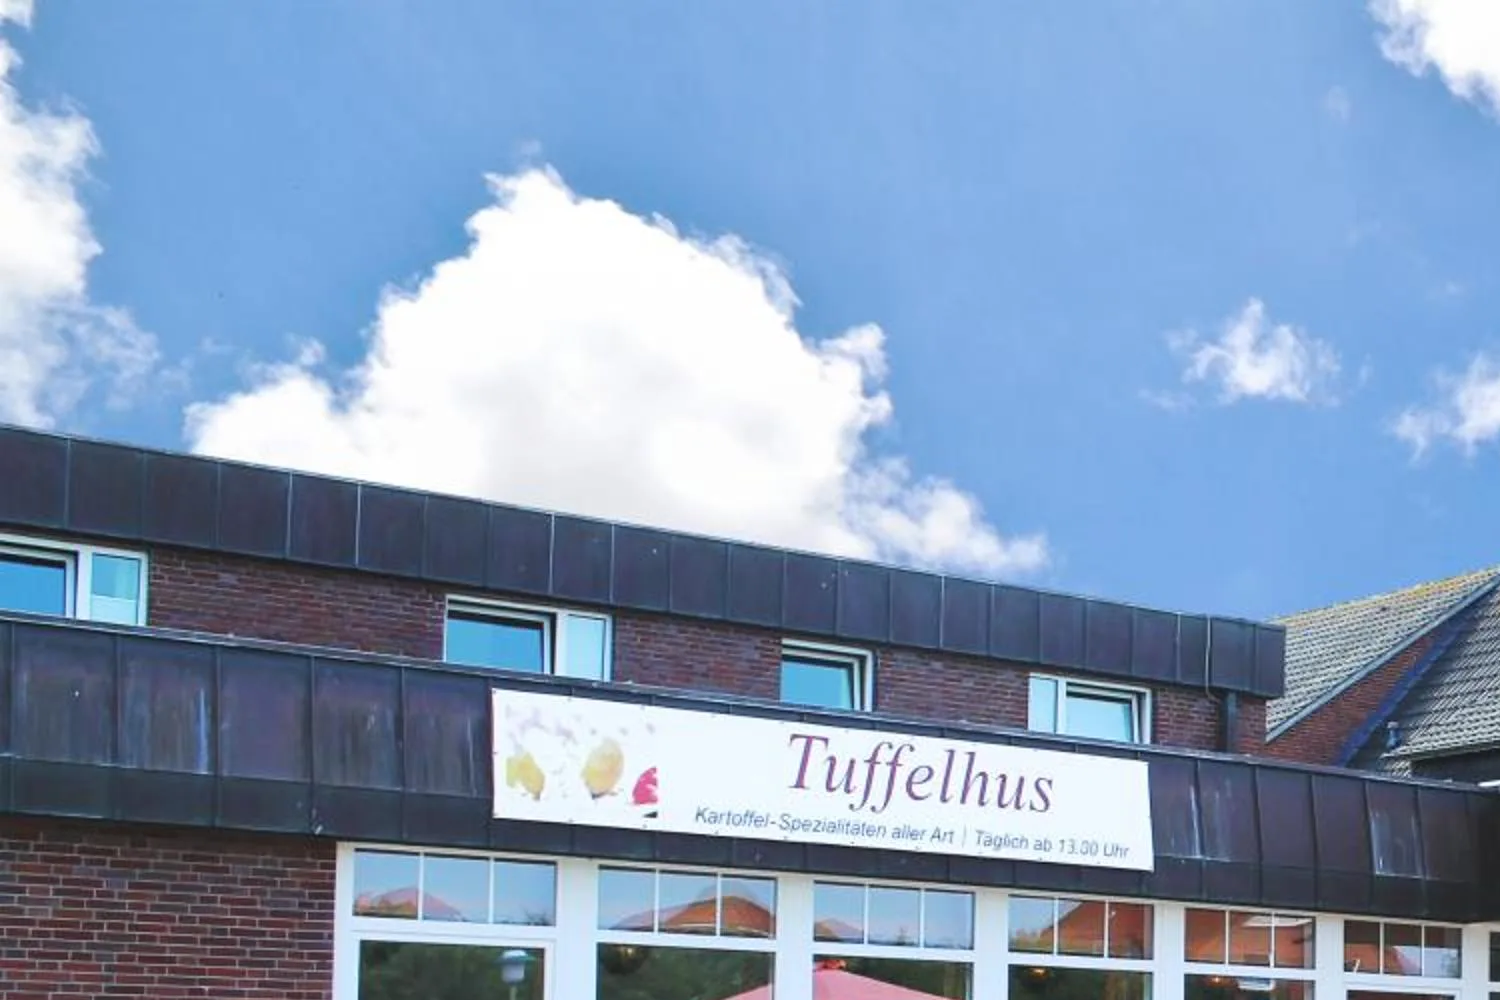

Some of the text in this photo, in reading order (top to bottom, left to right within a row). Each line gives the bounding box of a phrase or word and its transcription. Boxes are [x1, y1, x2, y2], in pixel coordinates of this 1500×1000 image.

[788, 732, 1054, 815] Tuffelhus
[891, 824, 926, 842] aller
[930, 826, 955, 844] Art
[1033, 838, 1053, 853] ab
[1102, 842, 1130, 859] Uhr
